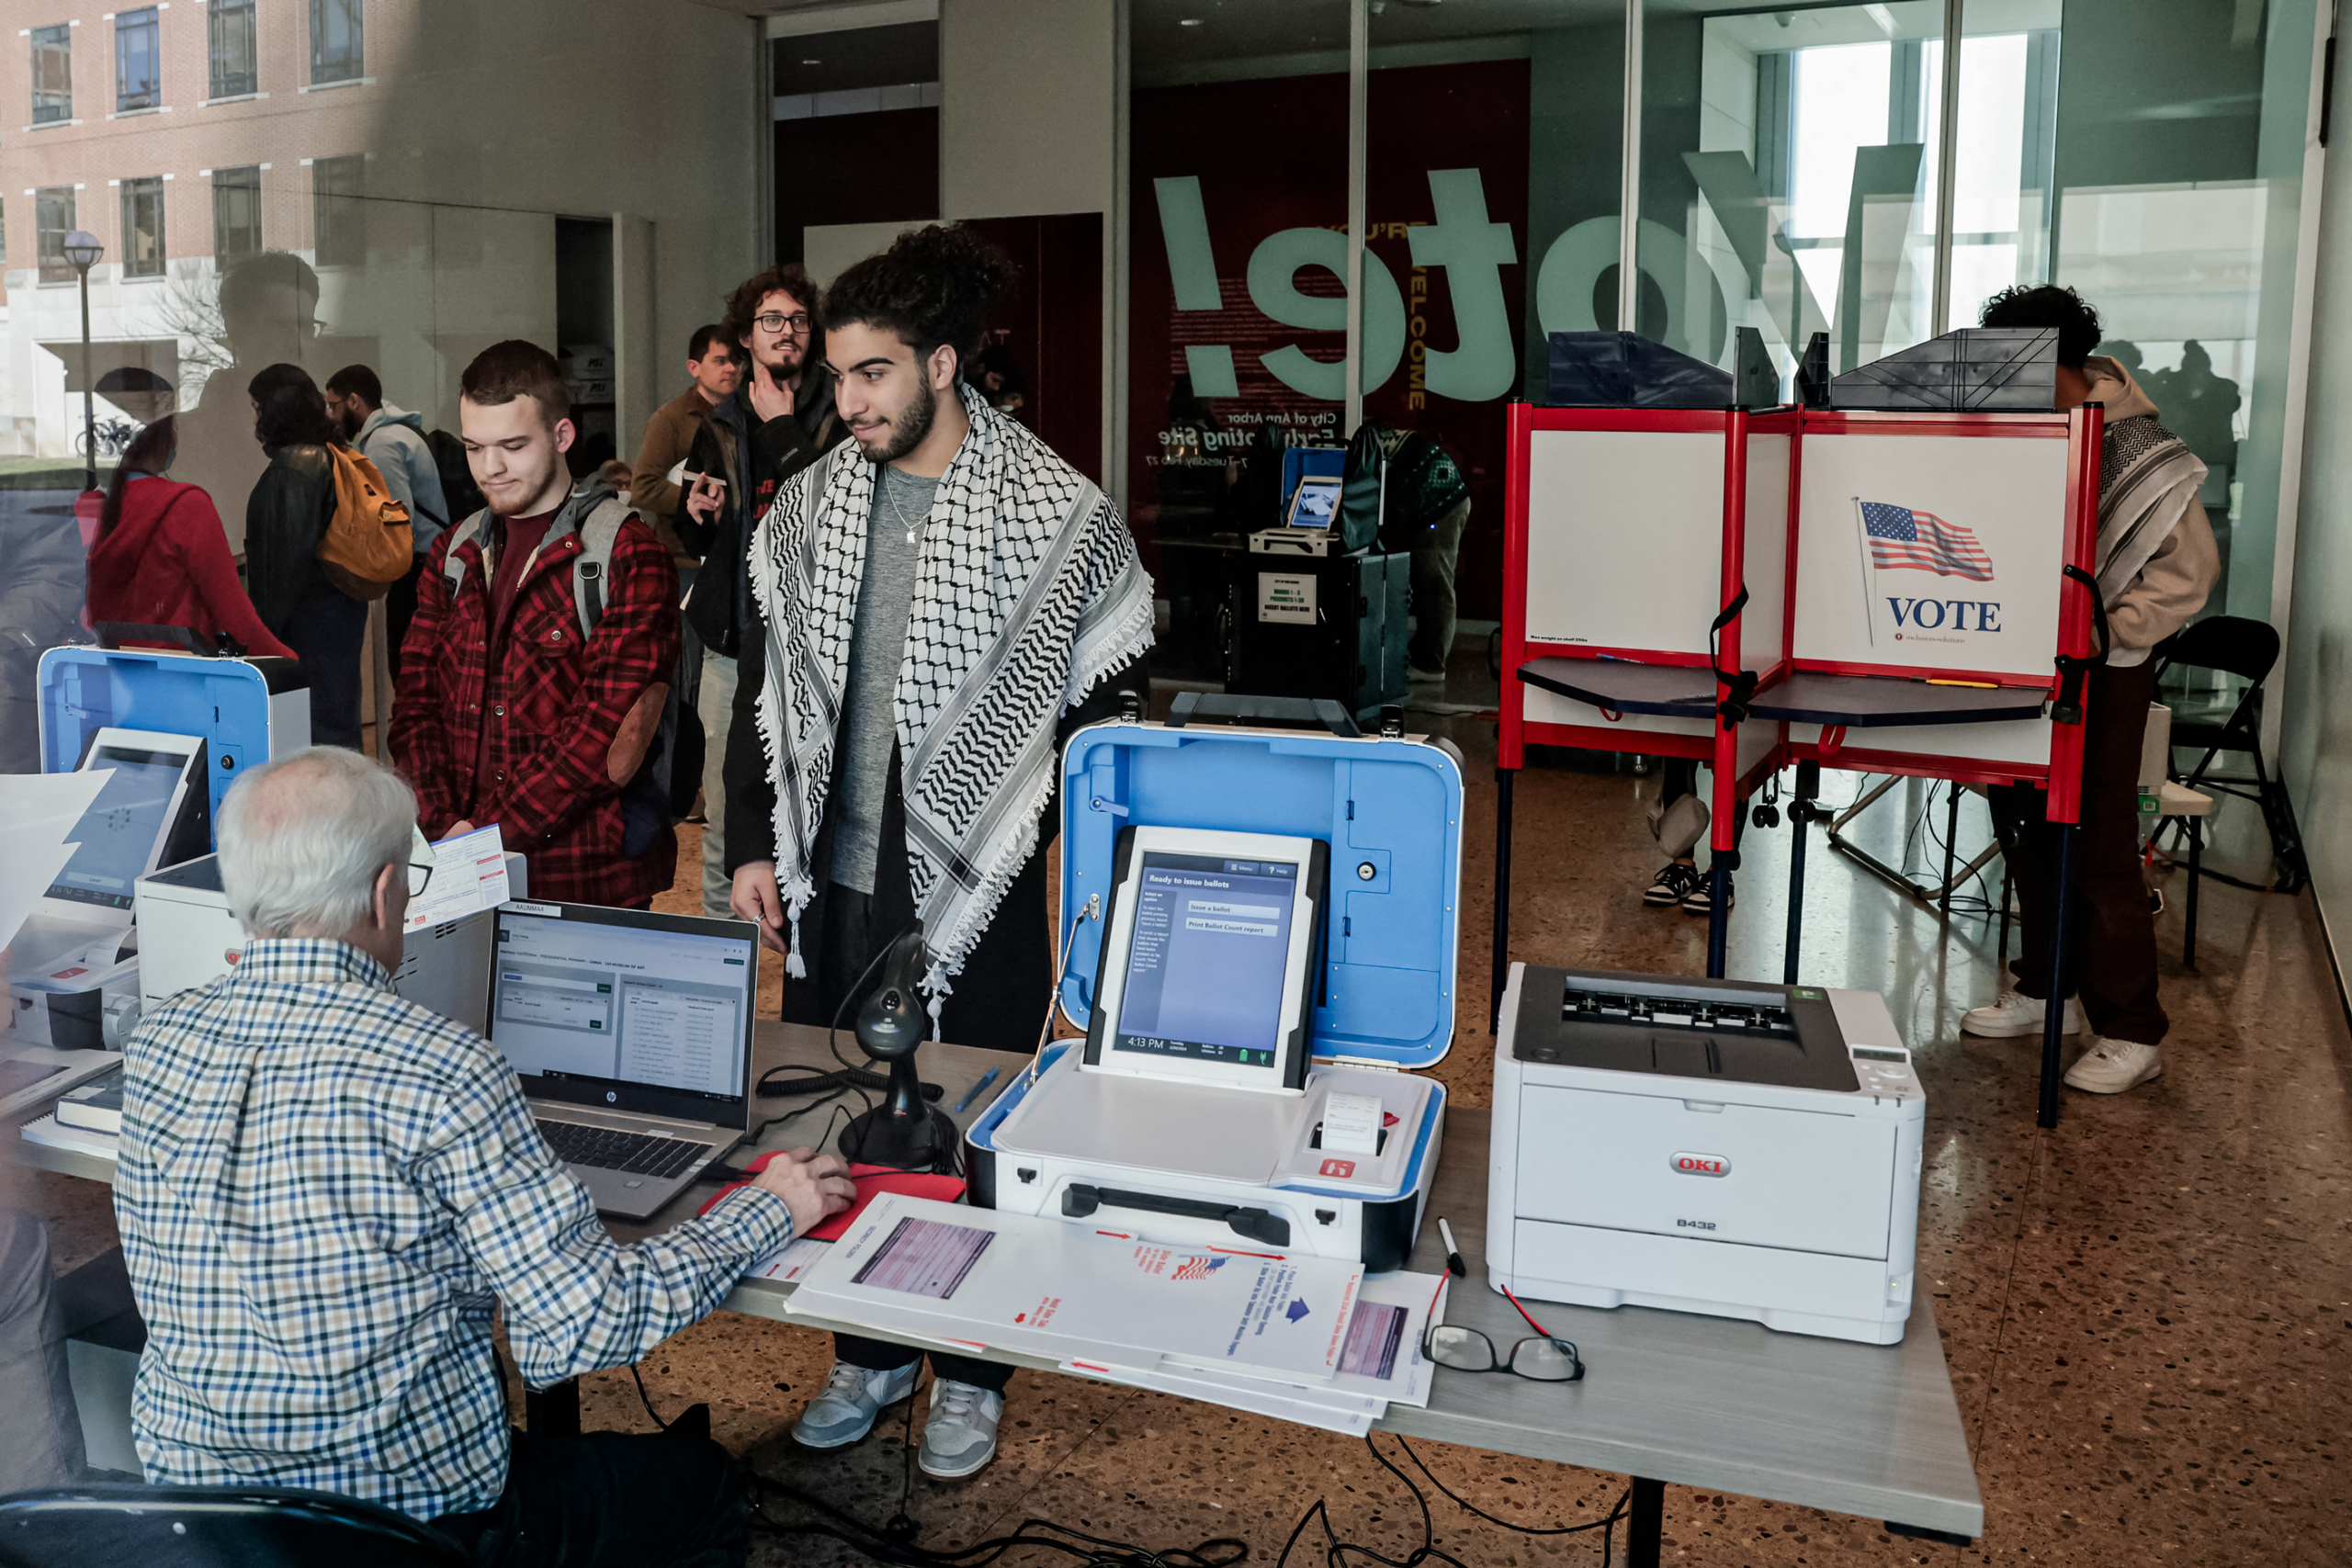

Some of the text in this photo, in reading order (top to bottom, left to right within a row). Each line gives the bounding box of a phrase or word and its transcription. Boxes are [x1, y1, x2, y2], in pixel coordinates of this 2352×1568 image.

[1886, 597, 2001, 632] VOTE
[1149, 874, 1172, 886] Ready
[1183, 876, 1203, 886] issue
[1204, 879, 1229, 888] ballots
[515, 904, 544, 912] AAUMMA4
[1244, 926, 1263, 934] report
[1127, 1036, 1146, 1047] 4:13
[1148, 1039, 1164, 1049] PM
[1678, 1156, 1722, 1174] OKI
[1676, 1218, 1716, 1231] B432
